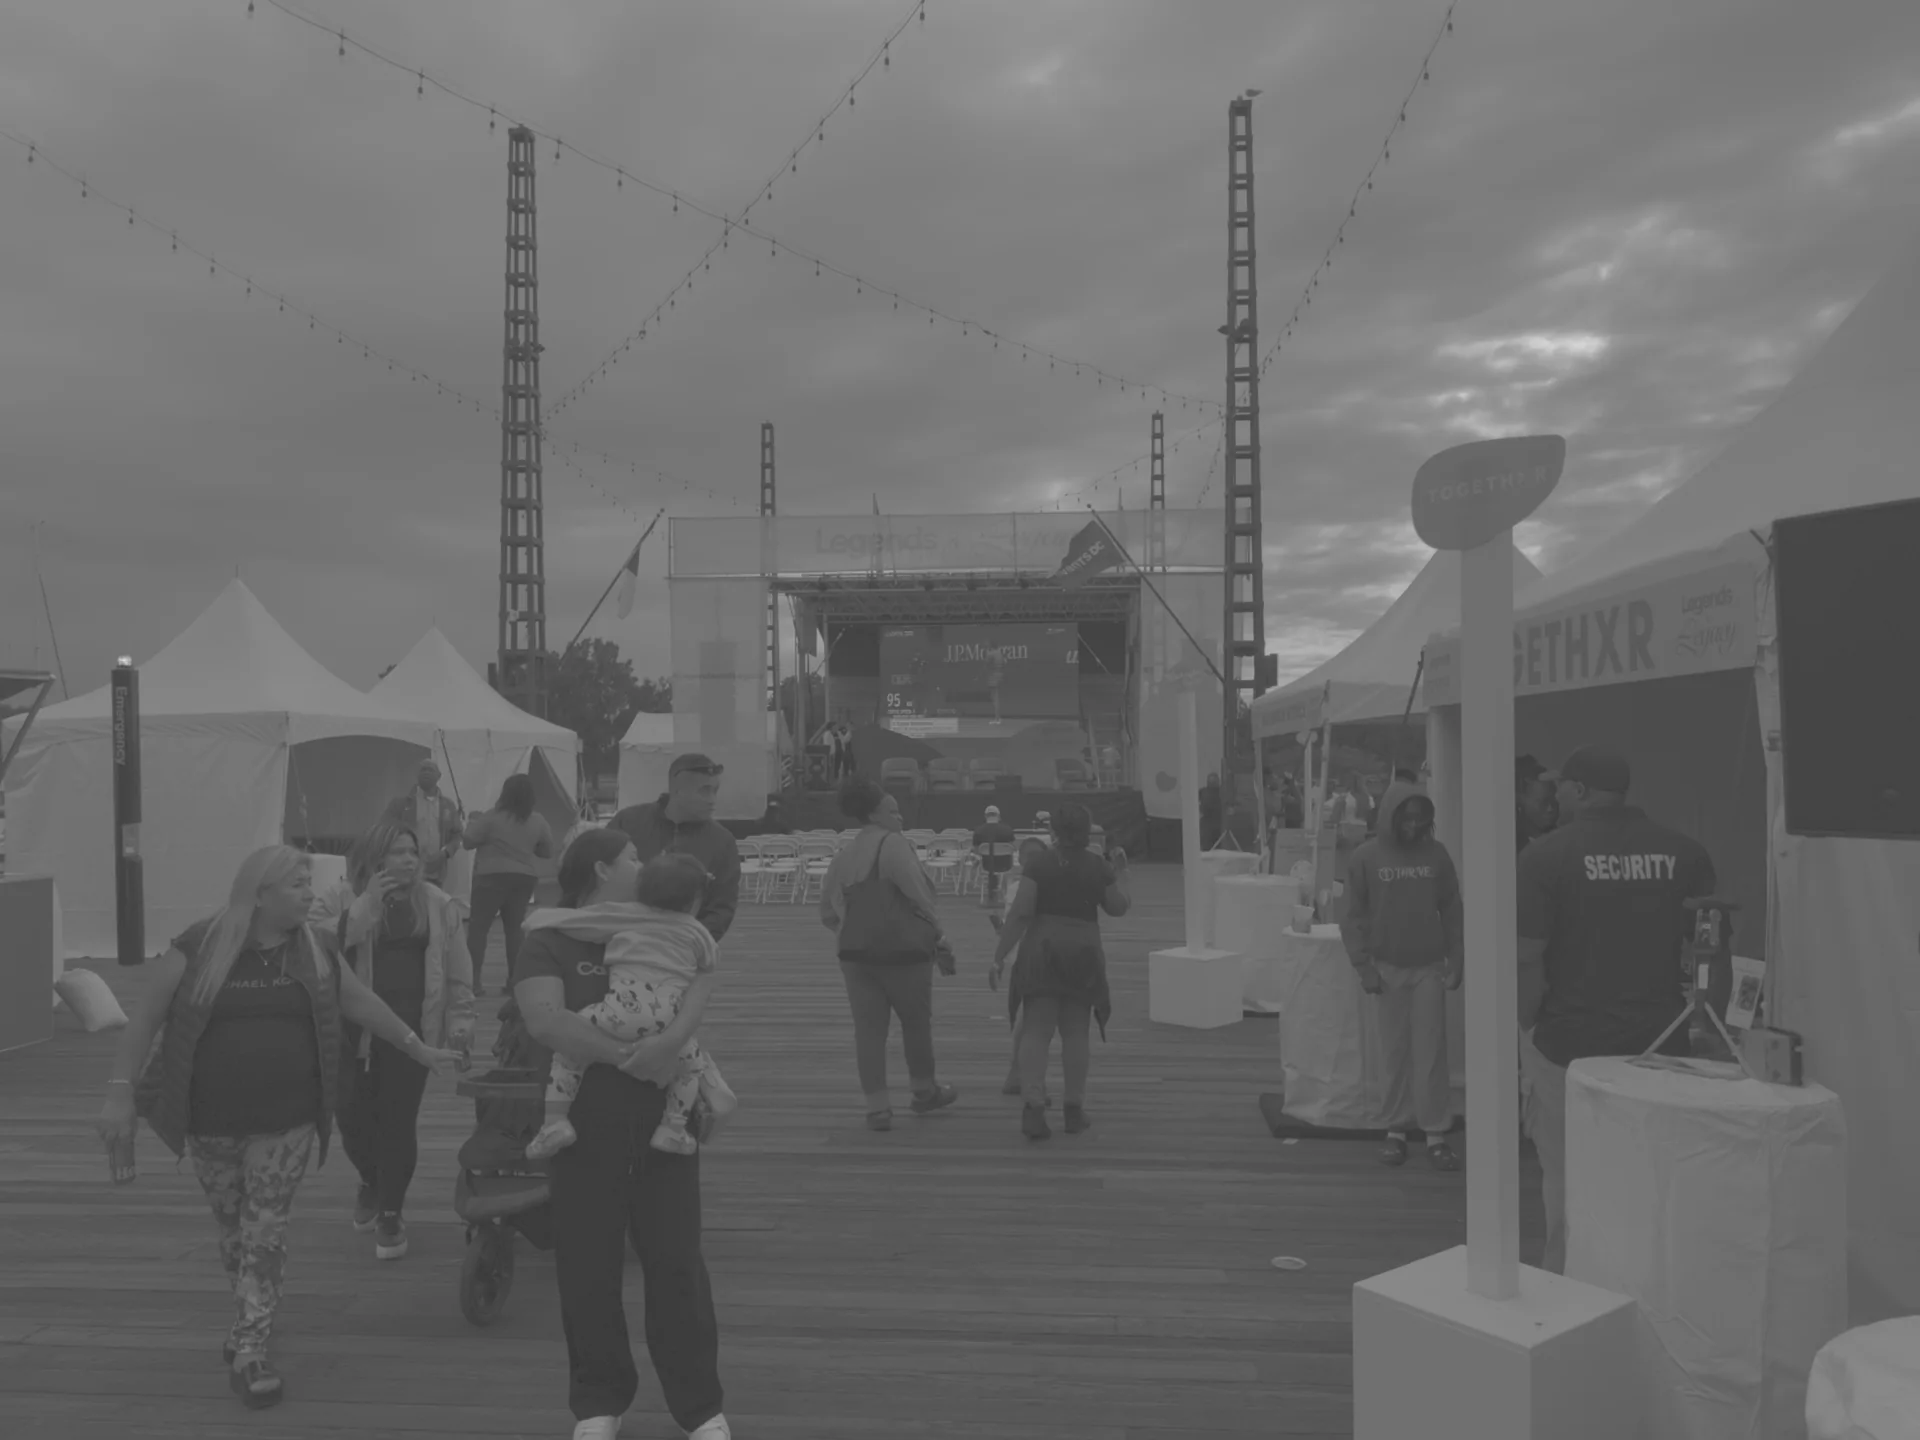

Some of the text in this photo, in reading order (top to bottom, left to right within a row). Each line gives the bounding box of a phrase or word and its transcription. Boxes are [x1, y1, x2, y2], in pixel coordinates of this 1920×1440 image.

[815, 526, 938, 560] Legends
[1681, 583, 1733, 616] Legends
[886, 693, 901, 707] 95
[115, 686, 127, 766] Emergency
[1584, 854, 1676, 881] SECURITY
